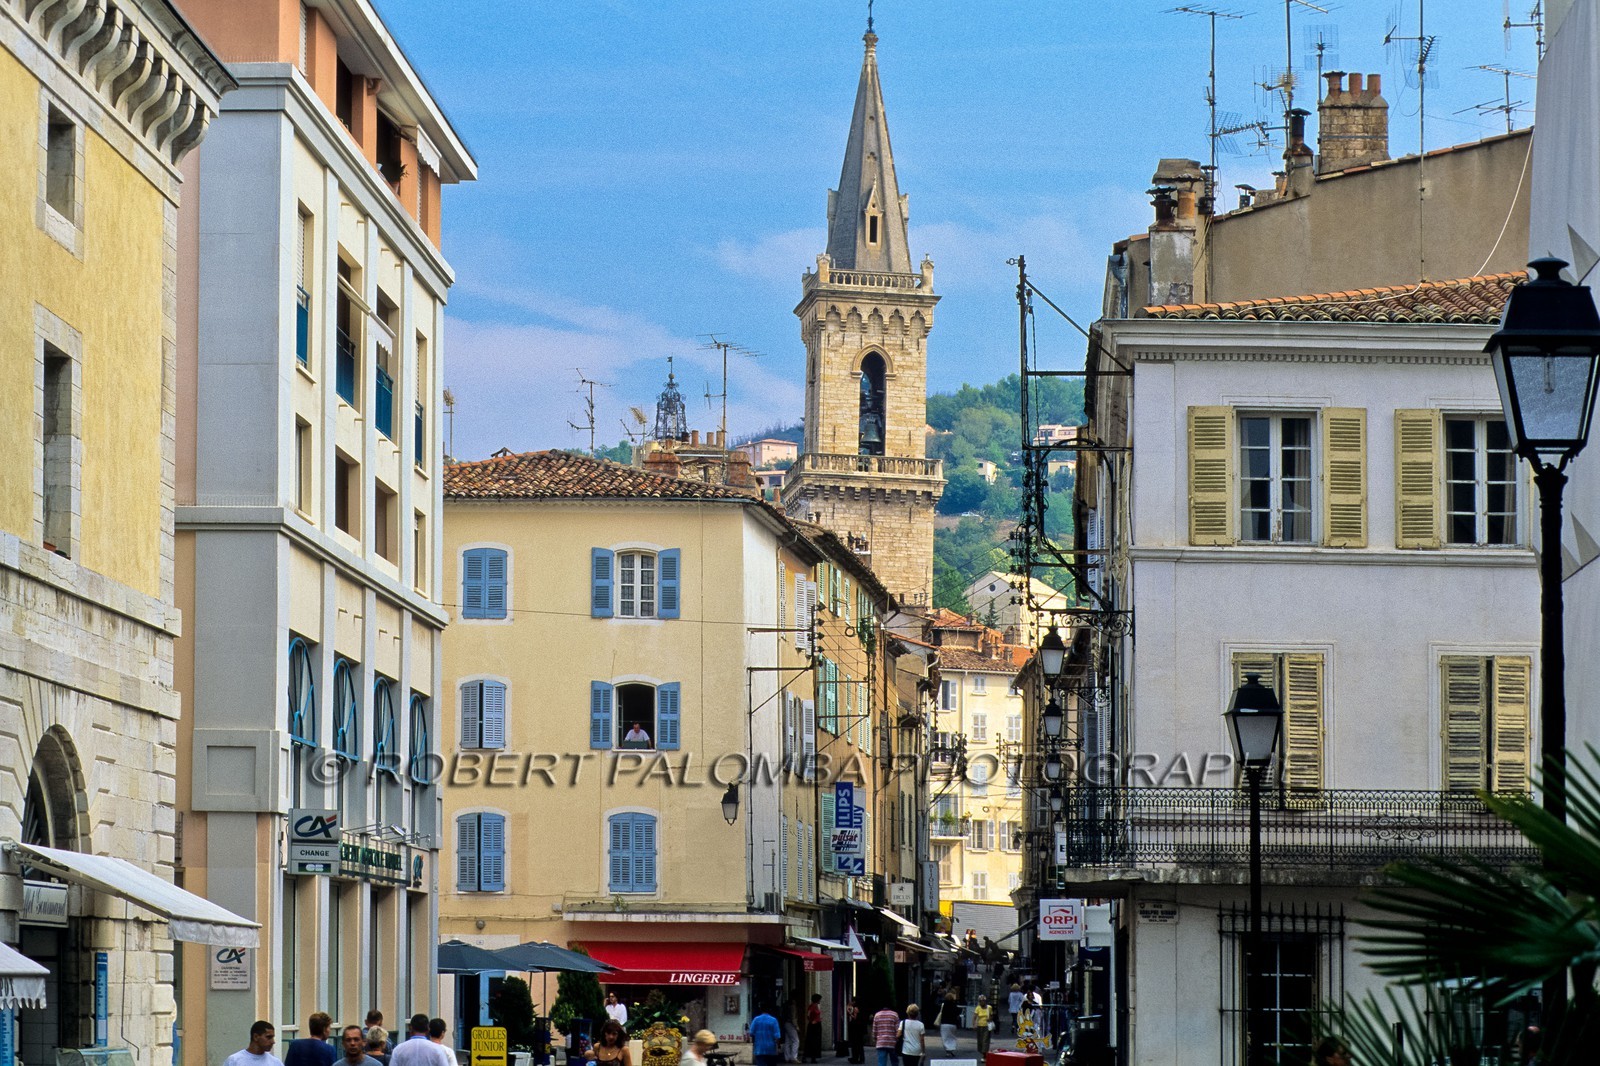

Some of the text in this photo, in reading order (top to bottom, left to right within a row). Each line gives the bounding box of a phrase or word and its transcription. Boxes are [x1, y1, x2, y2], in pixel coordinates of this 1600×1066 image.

[838, 789, 851, 826] ILIPS
[300, 849, 330, 857] CHANGE
[1043, 916, 1078, 925] ORPI
[669, 973, 736, 984] LINGERIE
[472, 1029, 506, 1040] GROLLES
[473, 1041, 505, 1051] JUNIOR
